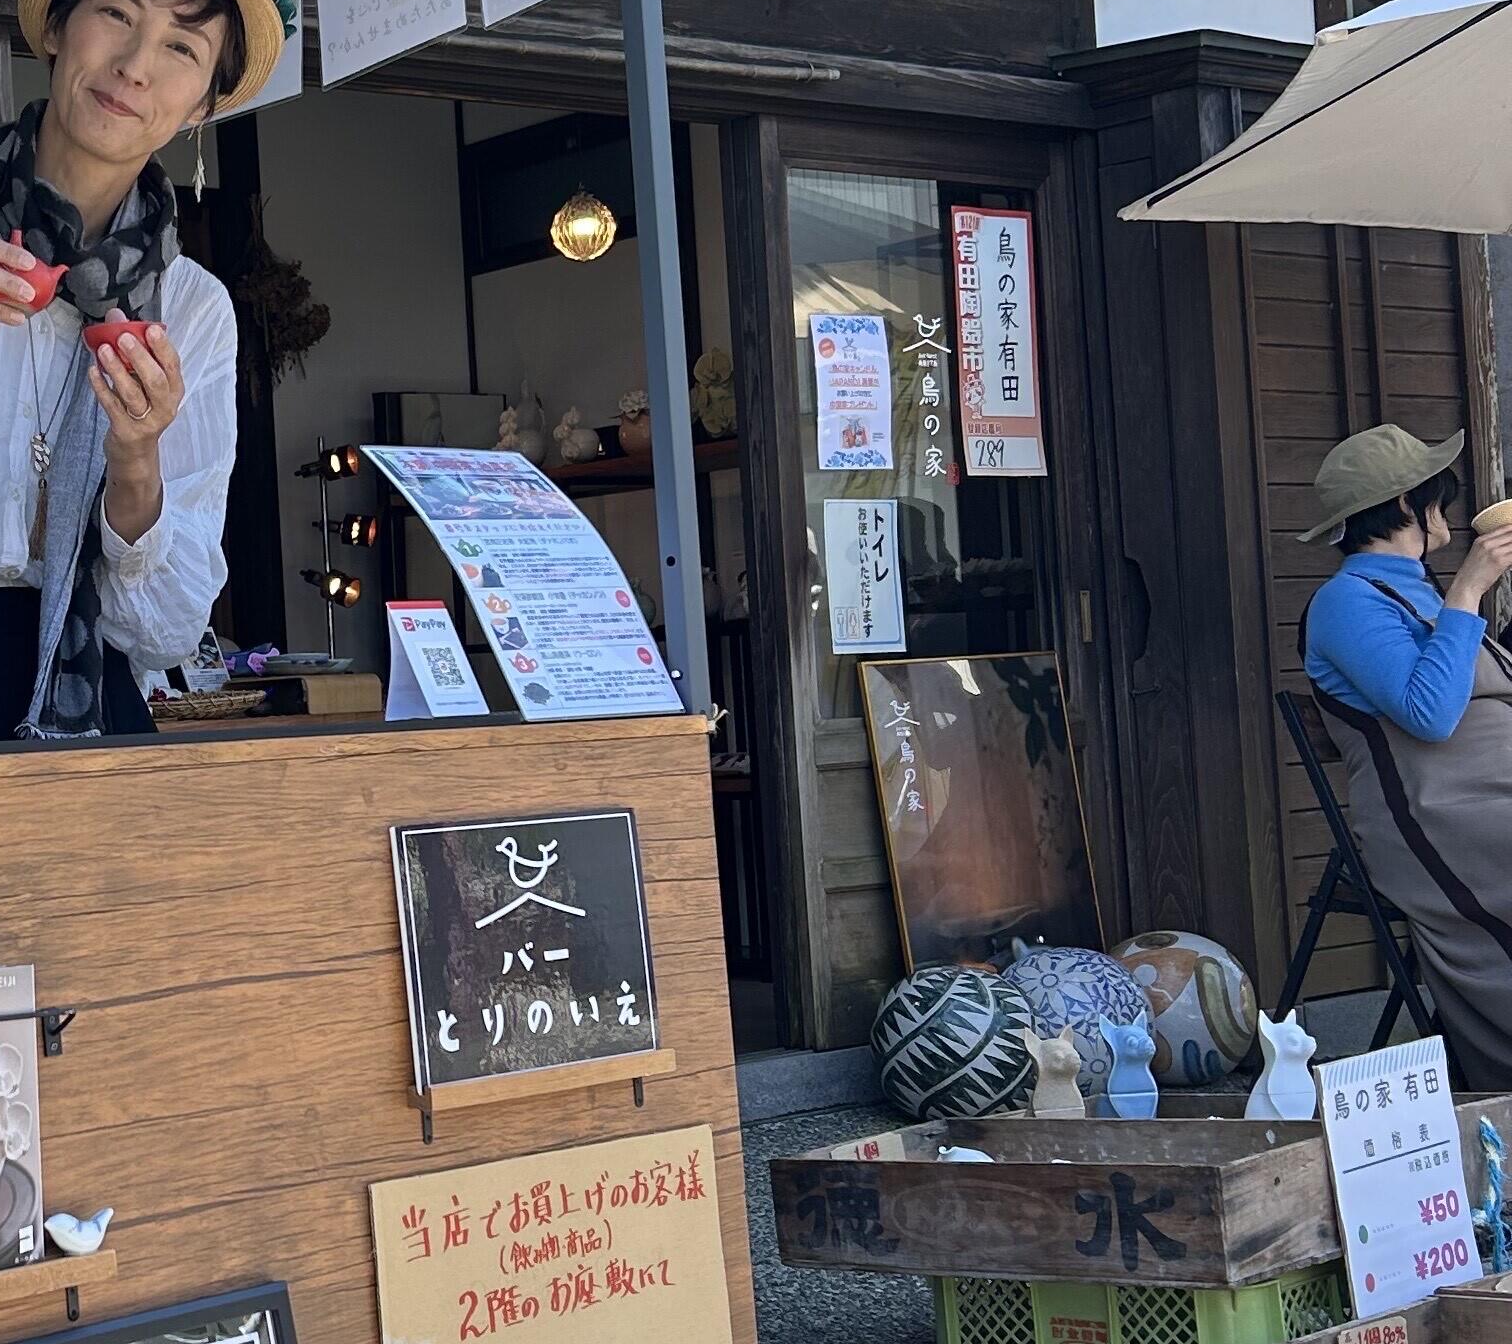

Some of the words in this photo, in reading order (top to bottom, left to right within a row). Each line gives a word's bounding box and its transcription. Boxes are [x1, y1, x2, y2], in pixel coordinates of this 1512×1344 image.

[997, 226, 1019, 402] 鳥の家有田
[919, 373, 947, 477] 鳥の家
[975, 439, 1004, 467] 289
[858, 507, 873, 638] お使いいただけます
[872, 508, 888, 582] トイレ
[415, 618, 446, 630] PayPay
[501, 946, 570, 977] バー
[435, 981, 642, 1054] とりのいえ
[1334, 1081, 1392, 1121] 鳥の家
[1404, 1068, 1440, 1102] 有田
[401, 1149, 706, 1262] 当店でお買上げのお客様
[1418, 1189, 1459, 1226] ¥50
[1414, 1239, 1469, 1280] ¥200
